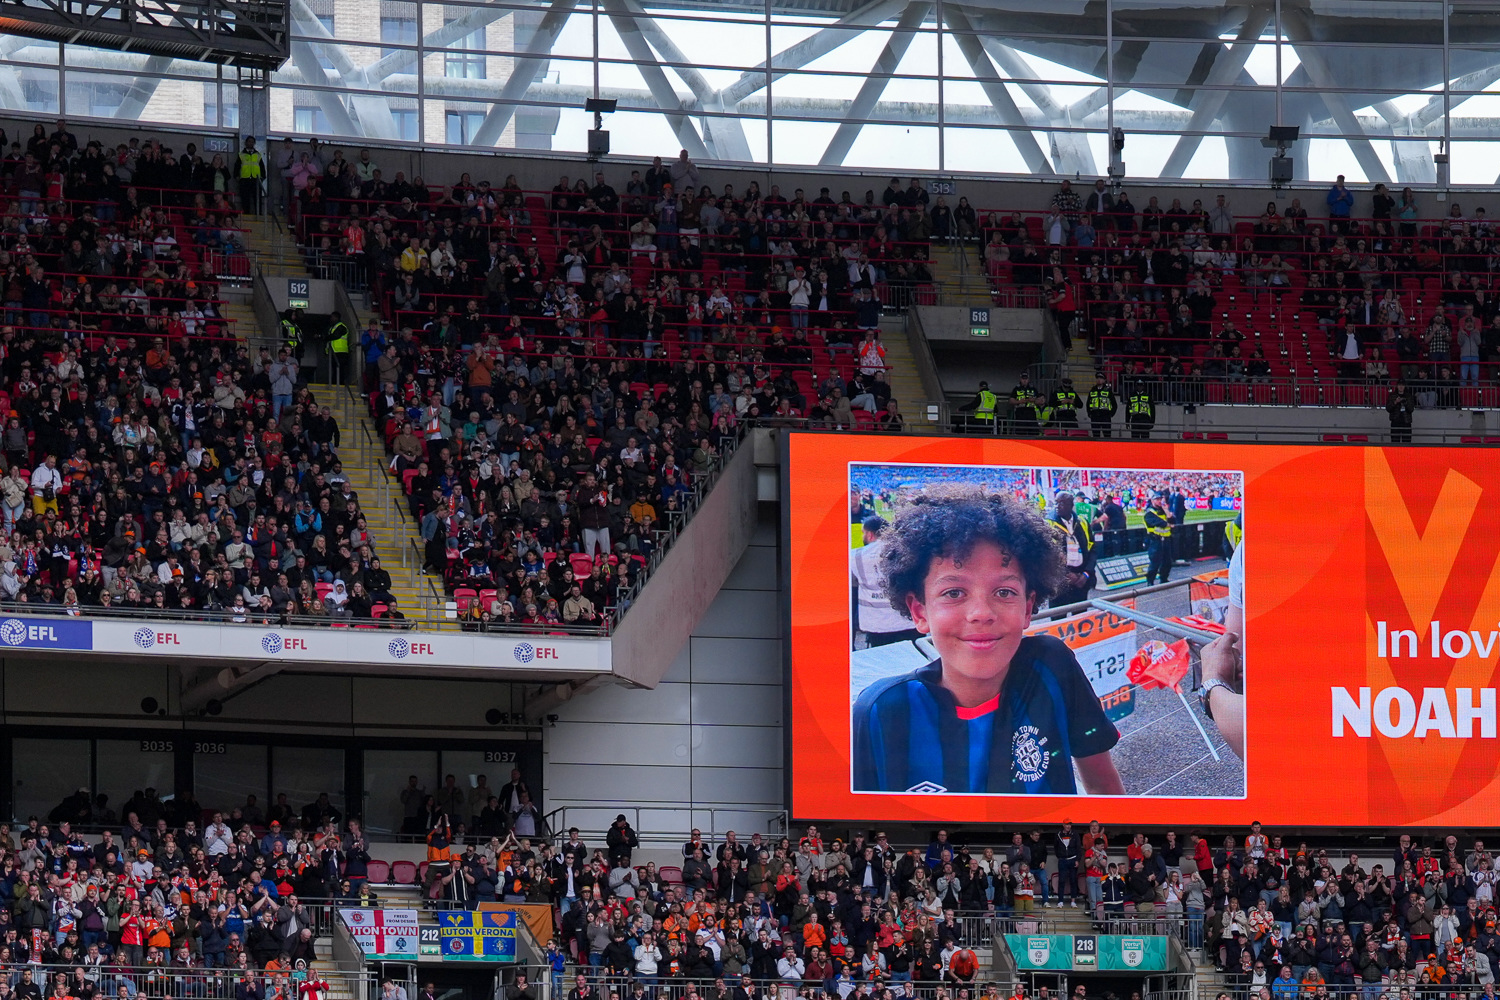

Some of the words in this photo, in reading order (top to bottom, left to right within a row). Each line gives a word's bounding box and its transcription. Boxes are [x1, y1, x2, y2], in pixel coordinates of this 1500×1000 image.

[210, 140, 228, 151] 512
[932, 182, 950, 194] 513
[290, 283, 307, 294] 512
[972, 312, 988, 322] 513
[29, 626, 58, 641] EFL
[157, 633, 180, 644] EFL
[1376, 620, 1418, 658] In
[284, 638, 307, 650] EFL
[411, 643, 434, 655] EFL
[536, 648, 558, 659] EFL
[1330, 686, 1497, 739] NOAH
[142, 741, 173, 751] 3035
[195, 743, 225, 753] 3036
[486, 751, 516, 762] 3037
[351, 926, 379, 936] UTON
[381, 926, 418, 936] TOWN
[421, 929, 439, 941] 212
[442, 927, 472, 936] LUTON
[474, 928, 514, 937] VERONA
[1077, 939, 1094, 951] 213
